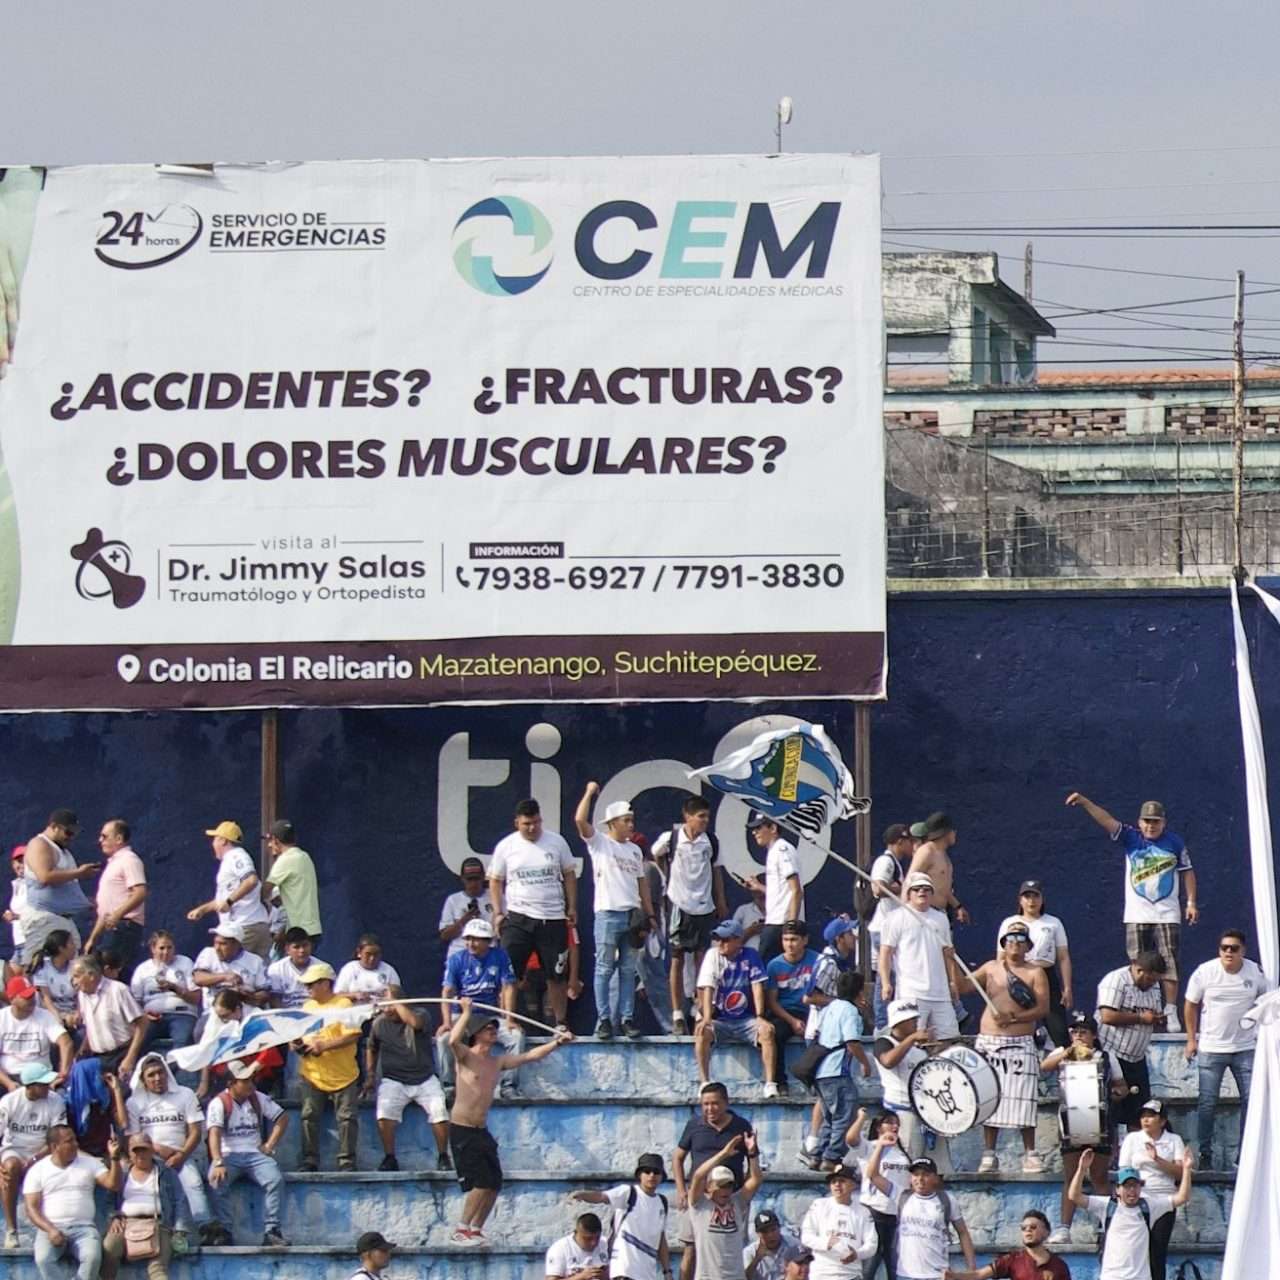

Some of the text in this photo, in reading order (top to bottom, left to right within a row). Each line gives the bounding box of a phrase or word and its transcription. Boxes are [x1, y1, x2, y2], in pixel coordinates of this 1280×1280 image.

[96, 211, 180, 246] 24 horas
[212, 213, 327, 228] SERVICIO DE
[209, 228, 387, 248] EMERGENCIAS
[574, 200, 842, 280] CEM
[572, 282, 844, 297] CENTRO DE ESPECIALIDADES MÉDICAS
[50, 369, 431, 421] ¿ACCIDENTES?
[473, 366, 843, 415] ¿FRACTURAS?
[106, 435, 788, 487] ¿DOLORES MUSCULARES?
[261, 535, 337, 551] visita al
[474, 543, 560, 557] INFORMACIÓN
[168, 555, 426, 584] Dr. Jimmy Salas
[472, 565, 646, 590] 7938-6927
[672, 563, 845, 589] 7791-3830
[169, 585, 426, 605] Traumatólogo y Ortopedista
[149, 646, 823, 682] Colonia El Relicario Mazatenango, Suchitepéquez.
